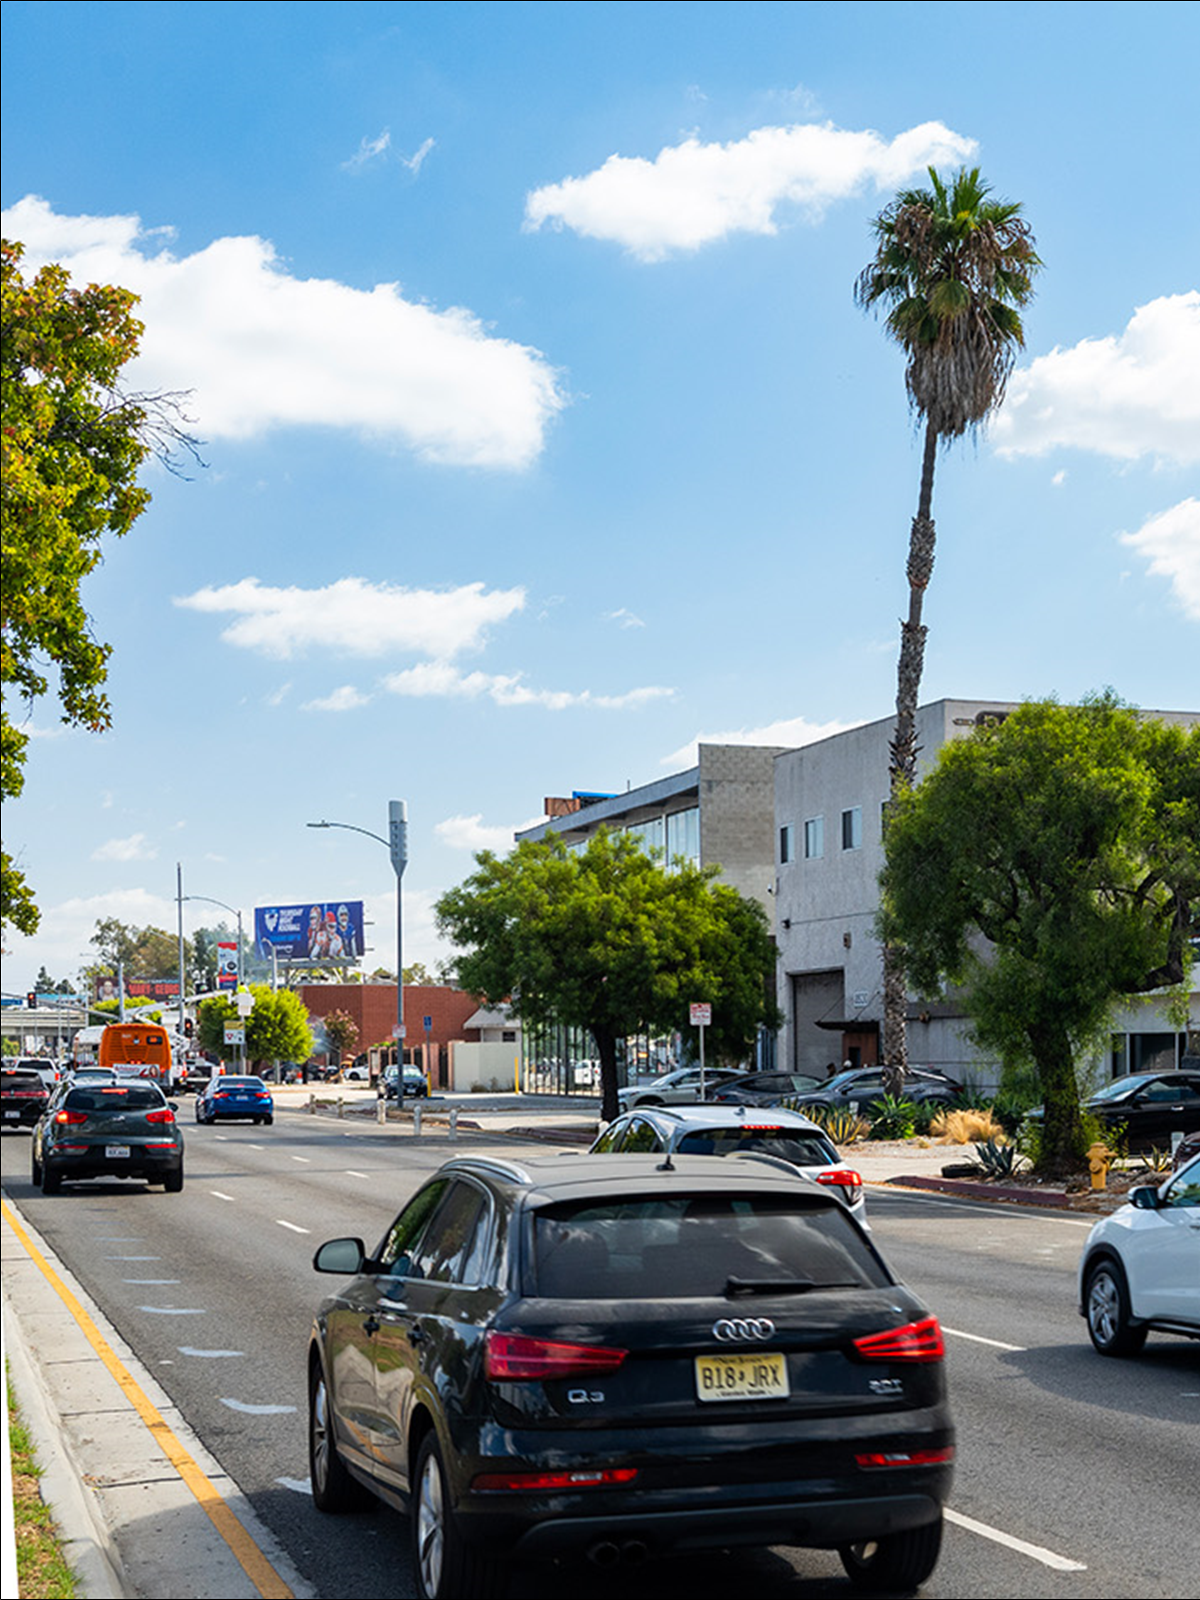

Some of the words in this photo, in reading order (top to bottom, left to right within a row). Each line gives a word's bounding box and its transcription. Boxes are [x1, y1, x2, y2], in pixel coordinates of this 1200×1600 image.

[702, 1367, 736, 1389] B18
[748, 1364, 781, 1388] JRX
[568, 1389, 605, 1403] Q3
